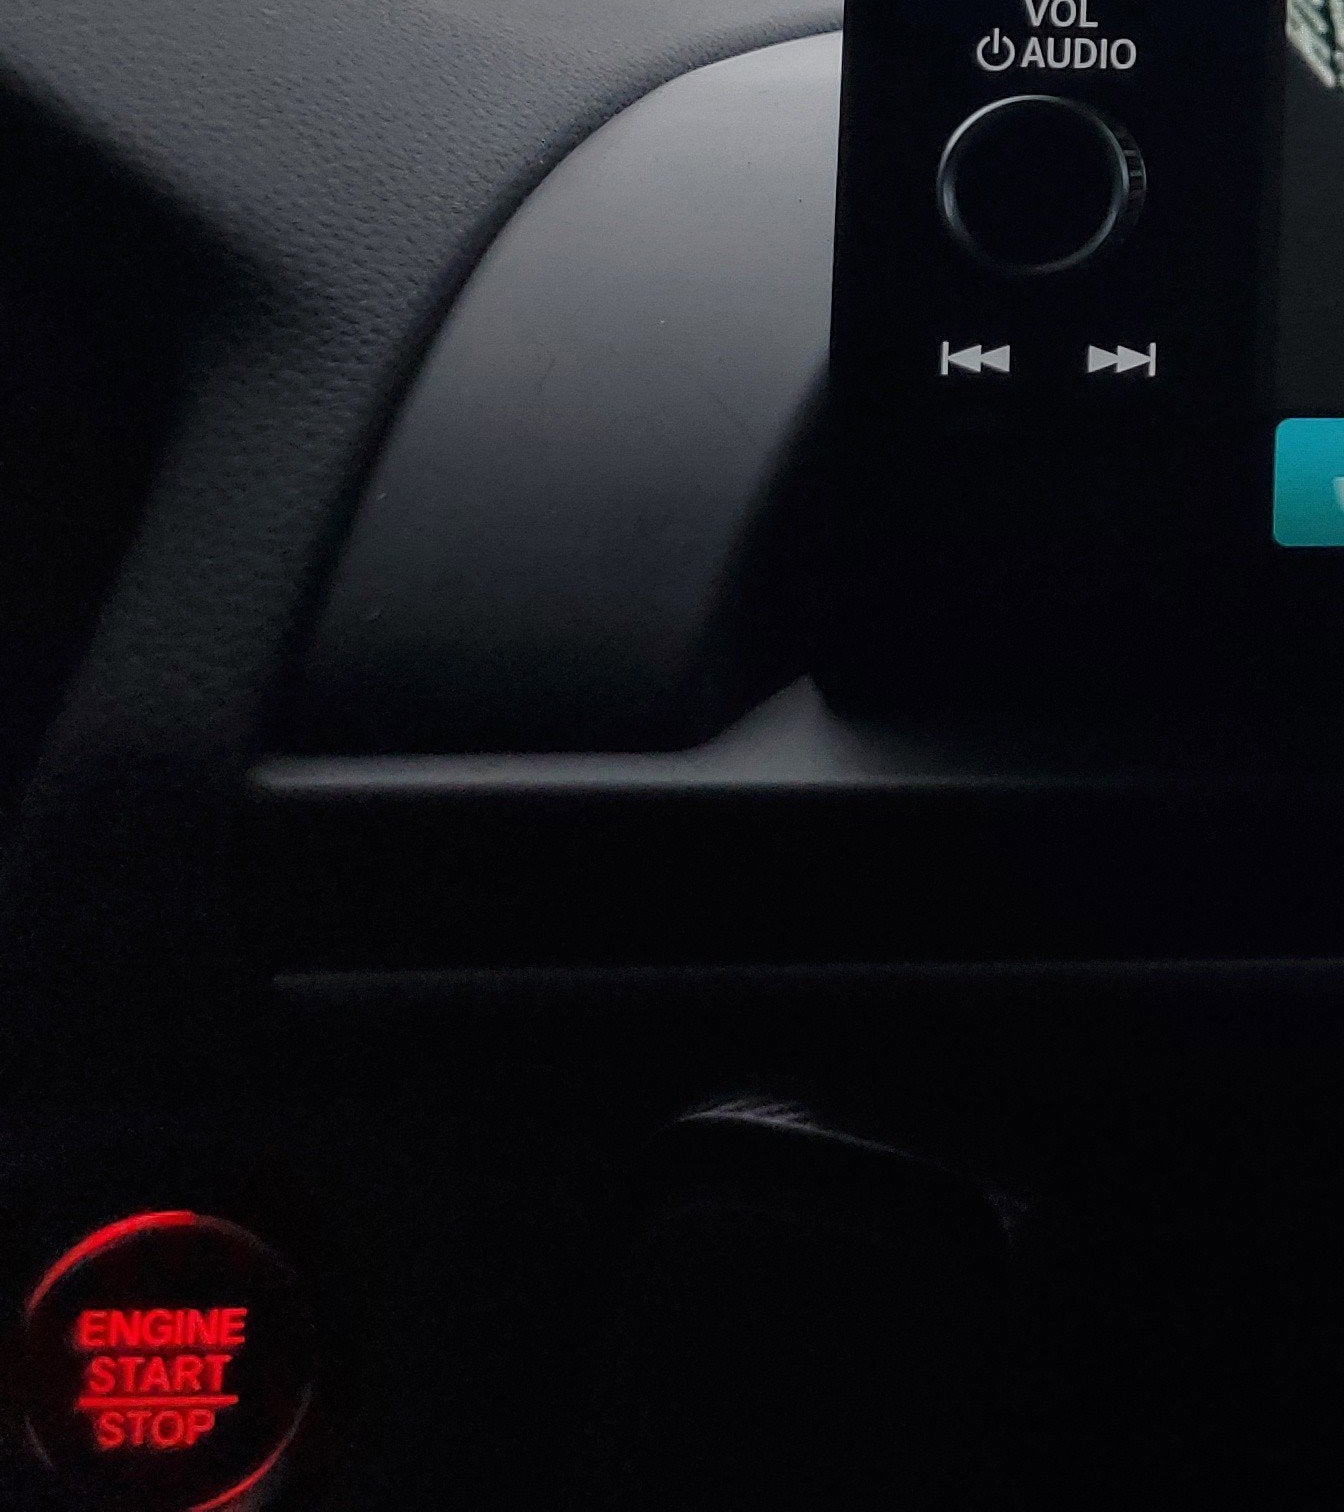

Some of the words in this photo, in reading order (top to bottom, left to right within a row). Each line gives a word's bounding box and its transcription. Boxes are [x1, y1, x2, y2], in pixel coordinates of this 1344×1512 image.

[1020, 36, 1137, 70] AUDIO
[76, 1307, 248, 1348] ENGINE
[88, 1354, 232, 1394] START
[97, 1409, 216, 1450] STOP
